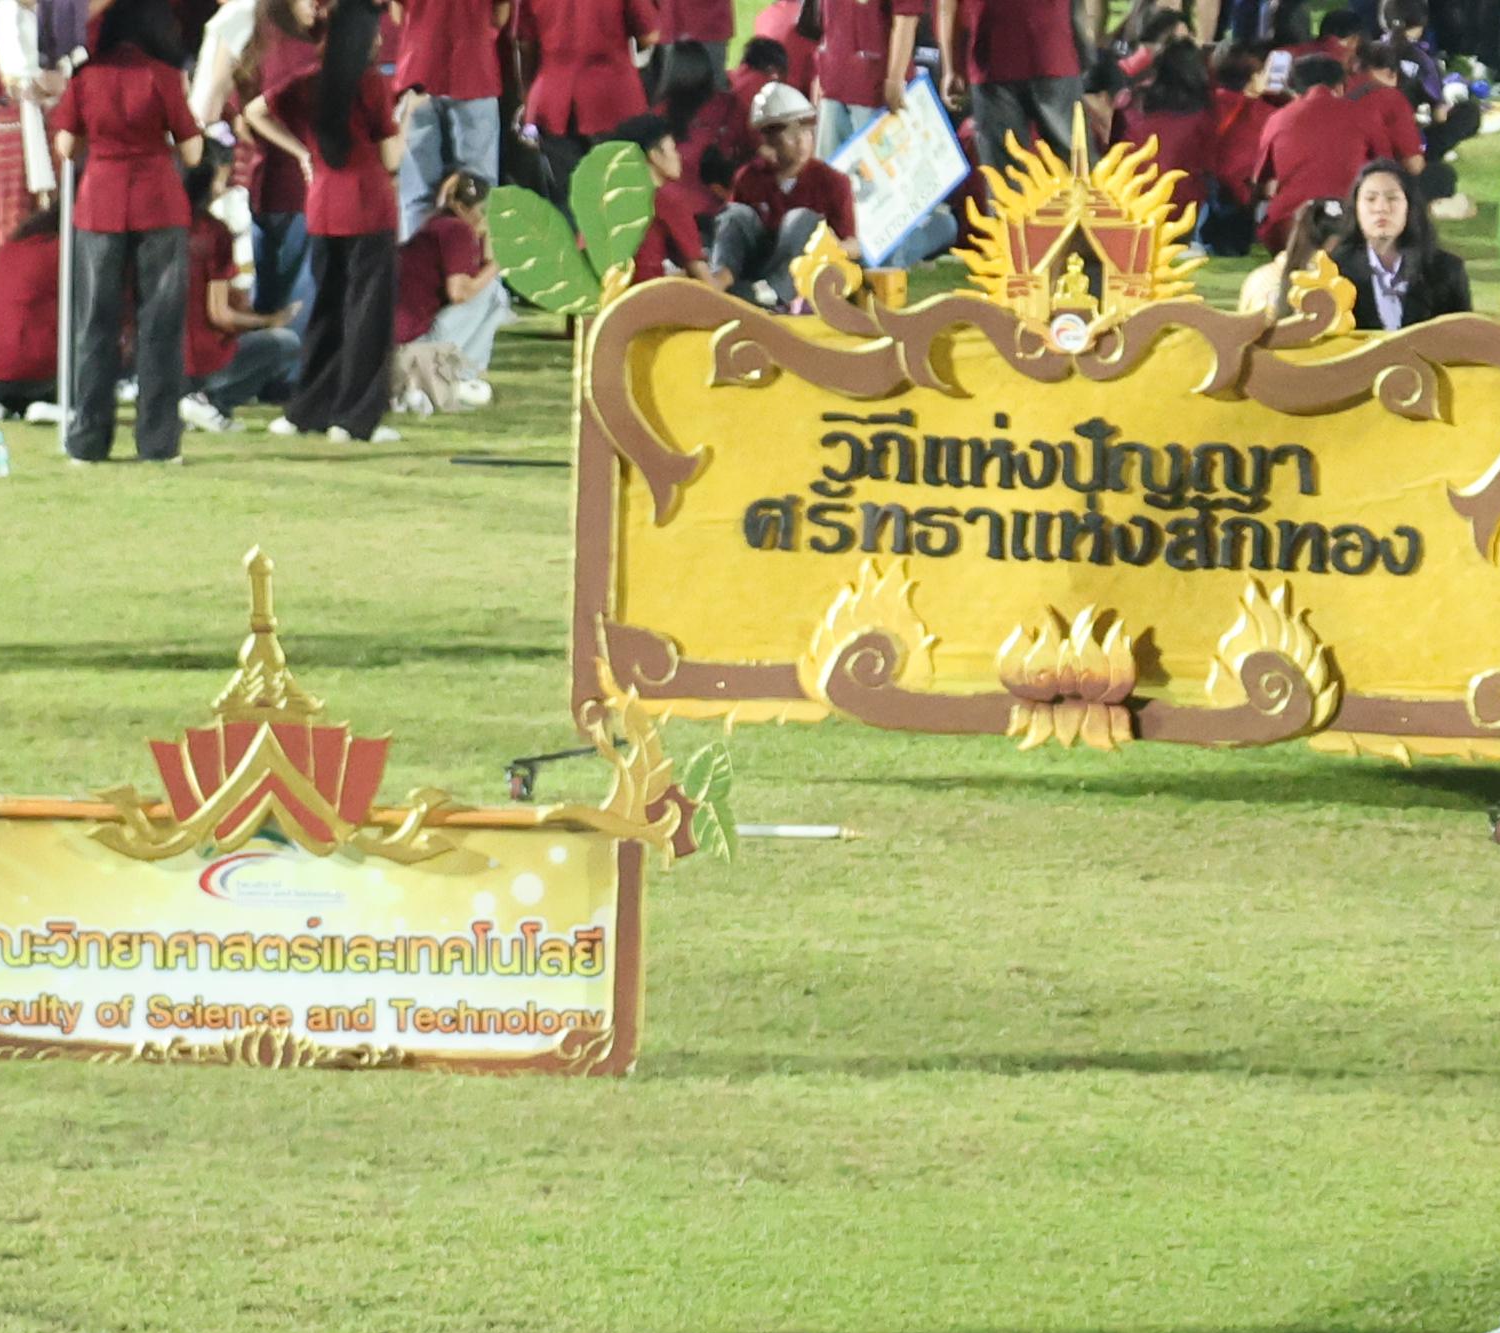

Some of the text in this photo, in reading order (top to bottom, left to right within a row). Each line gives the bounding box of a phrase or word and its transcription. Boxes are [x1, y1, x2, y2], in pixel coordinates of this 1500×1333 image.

[95, 994, 134, 1027] of
[146, 994, 292, 1030] Science
[306, 999, 375, 1031] and
